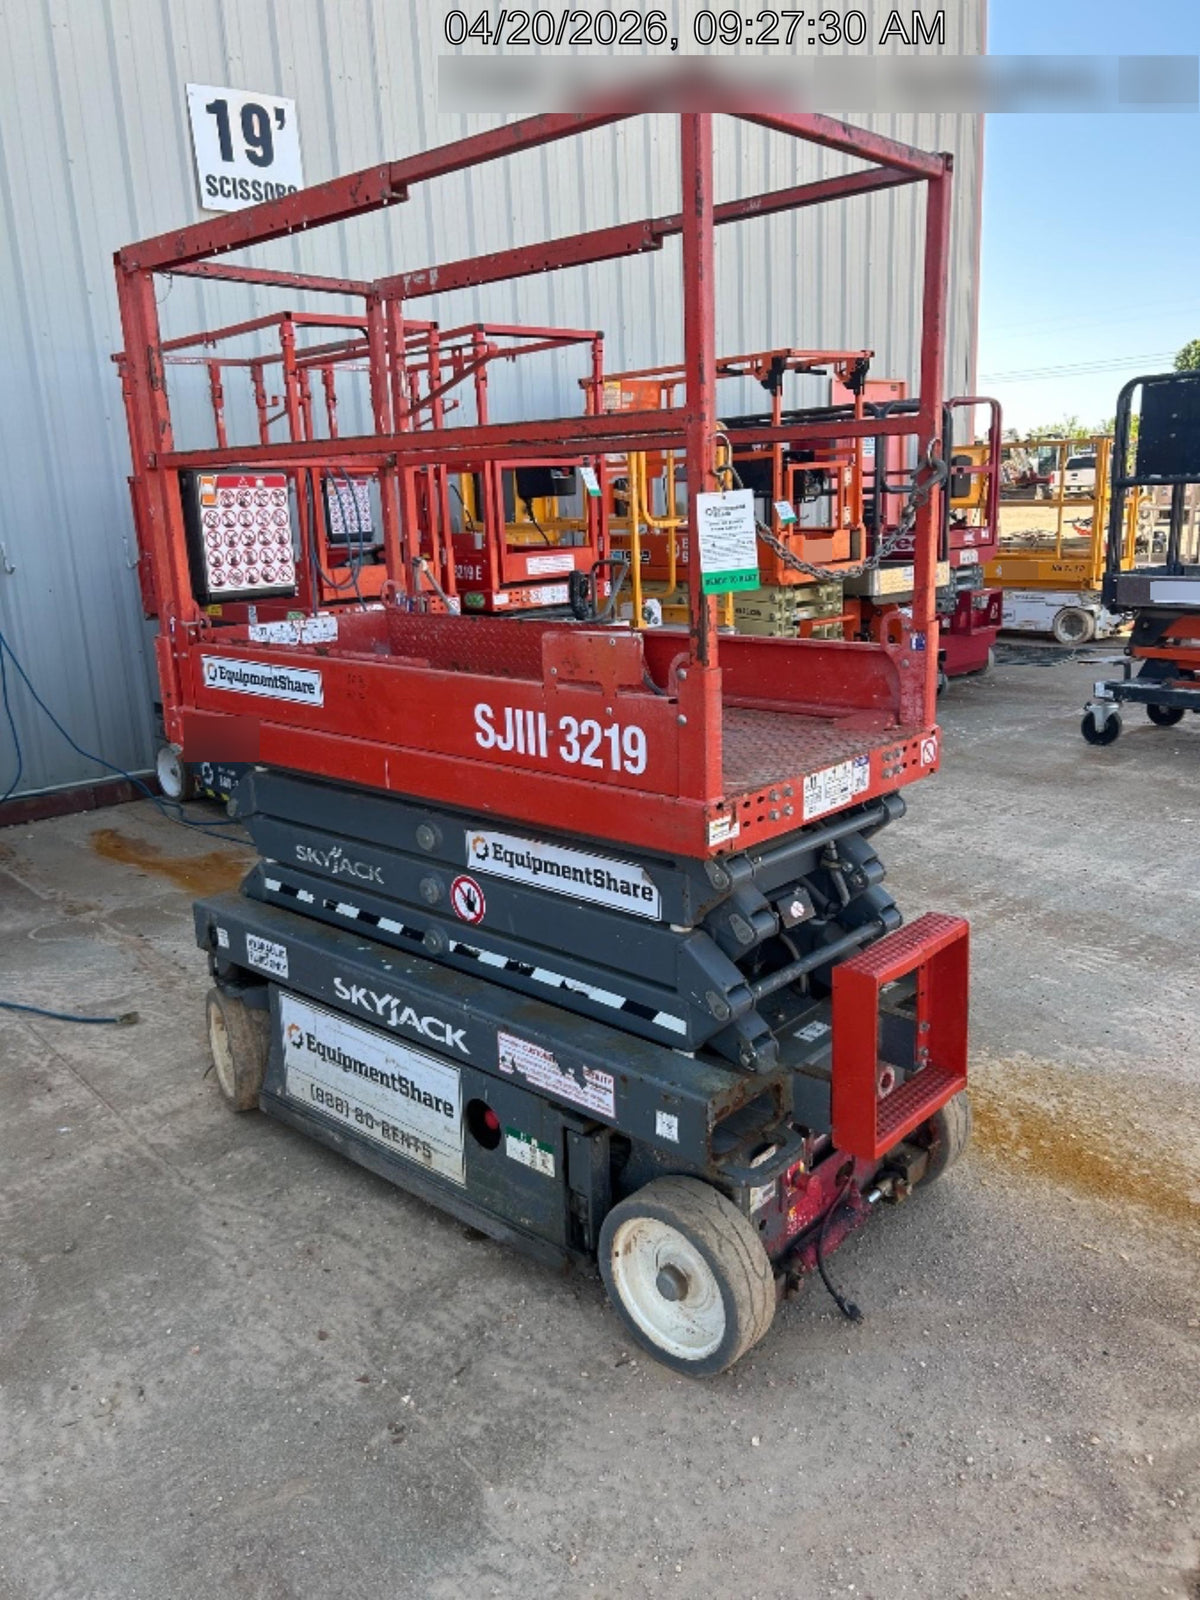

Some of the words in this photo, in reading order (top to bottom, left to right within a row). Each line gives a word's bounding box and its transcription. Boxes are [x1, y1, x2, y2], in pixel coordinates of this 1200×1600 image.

[205, 99, 286, 168] 19'
[218, 665, 316, 695] EquipmentShare
[474, 703, 548, 758] SJIII
[559, 715, 647, 776] 3219
[296, 845, 385, 885] SKYJACK
[492, 842, 653, 901] EquipmentShare
[333, 977, 471, 1055] SKYJACK
[305, 1032, 455, 1118] EquipmentShare
